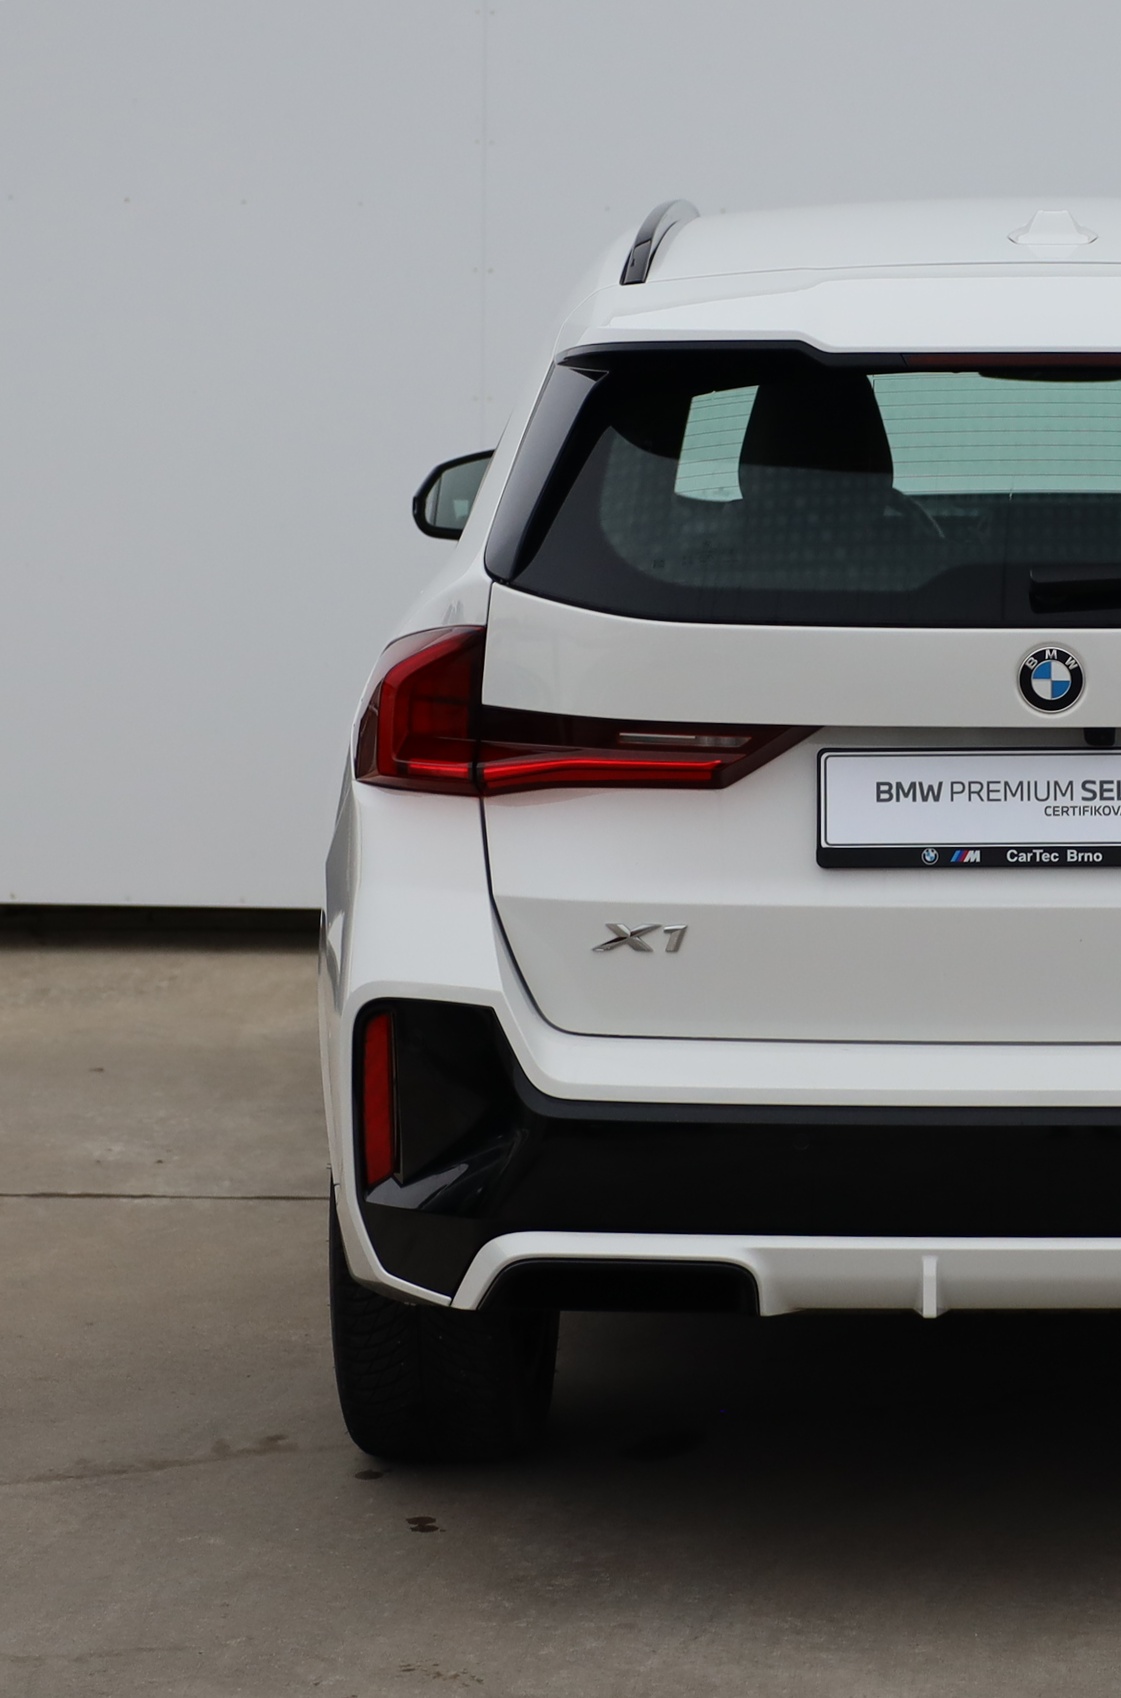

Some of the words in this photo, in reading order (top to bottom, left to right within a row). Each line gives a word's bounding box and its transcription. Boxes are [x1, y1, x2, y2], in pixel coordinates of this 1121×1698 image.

[1025, 649, 1078, 670] BMW
[875, 781, 943, 803] BMW
[950, 780, 1074, 802] PREMIUM
[1006, 849, 1060, 862] CarTec
[1066, 849, 1103, 862] Brno
[592, 923, 688, 952] X1
